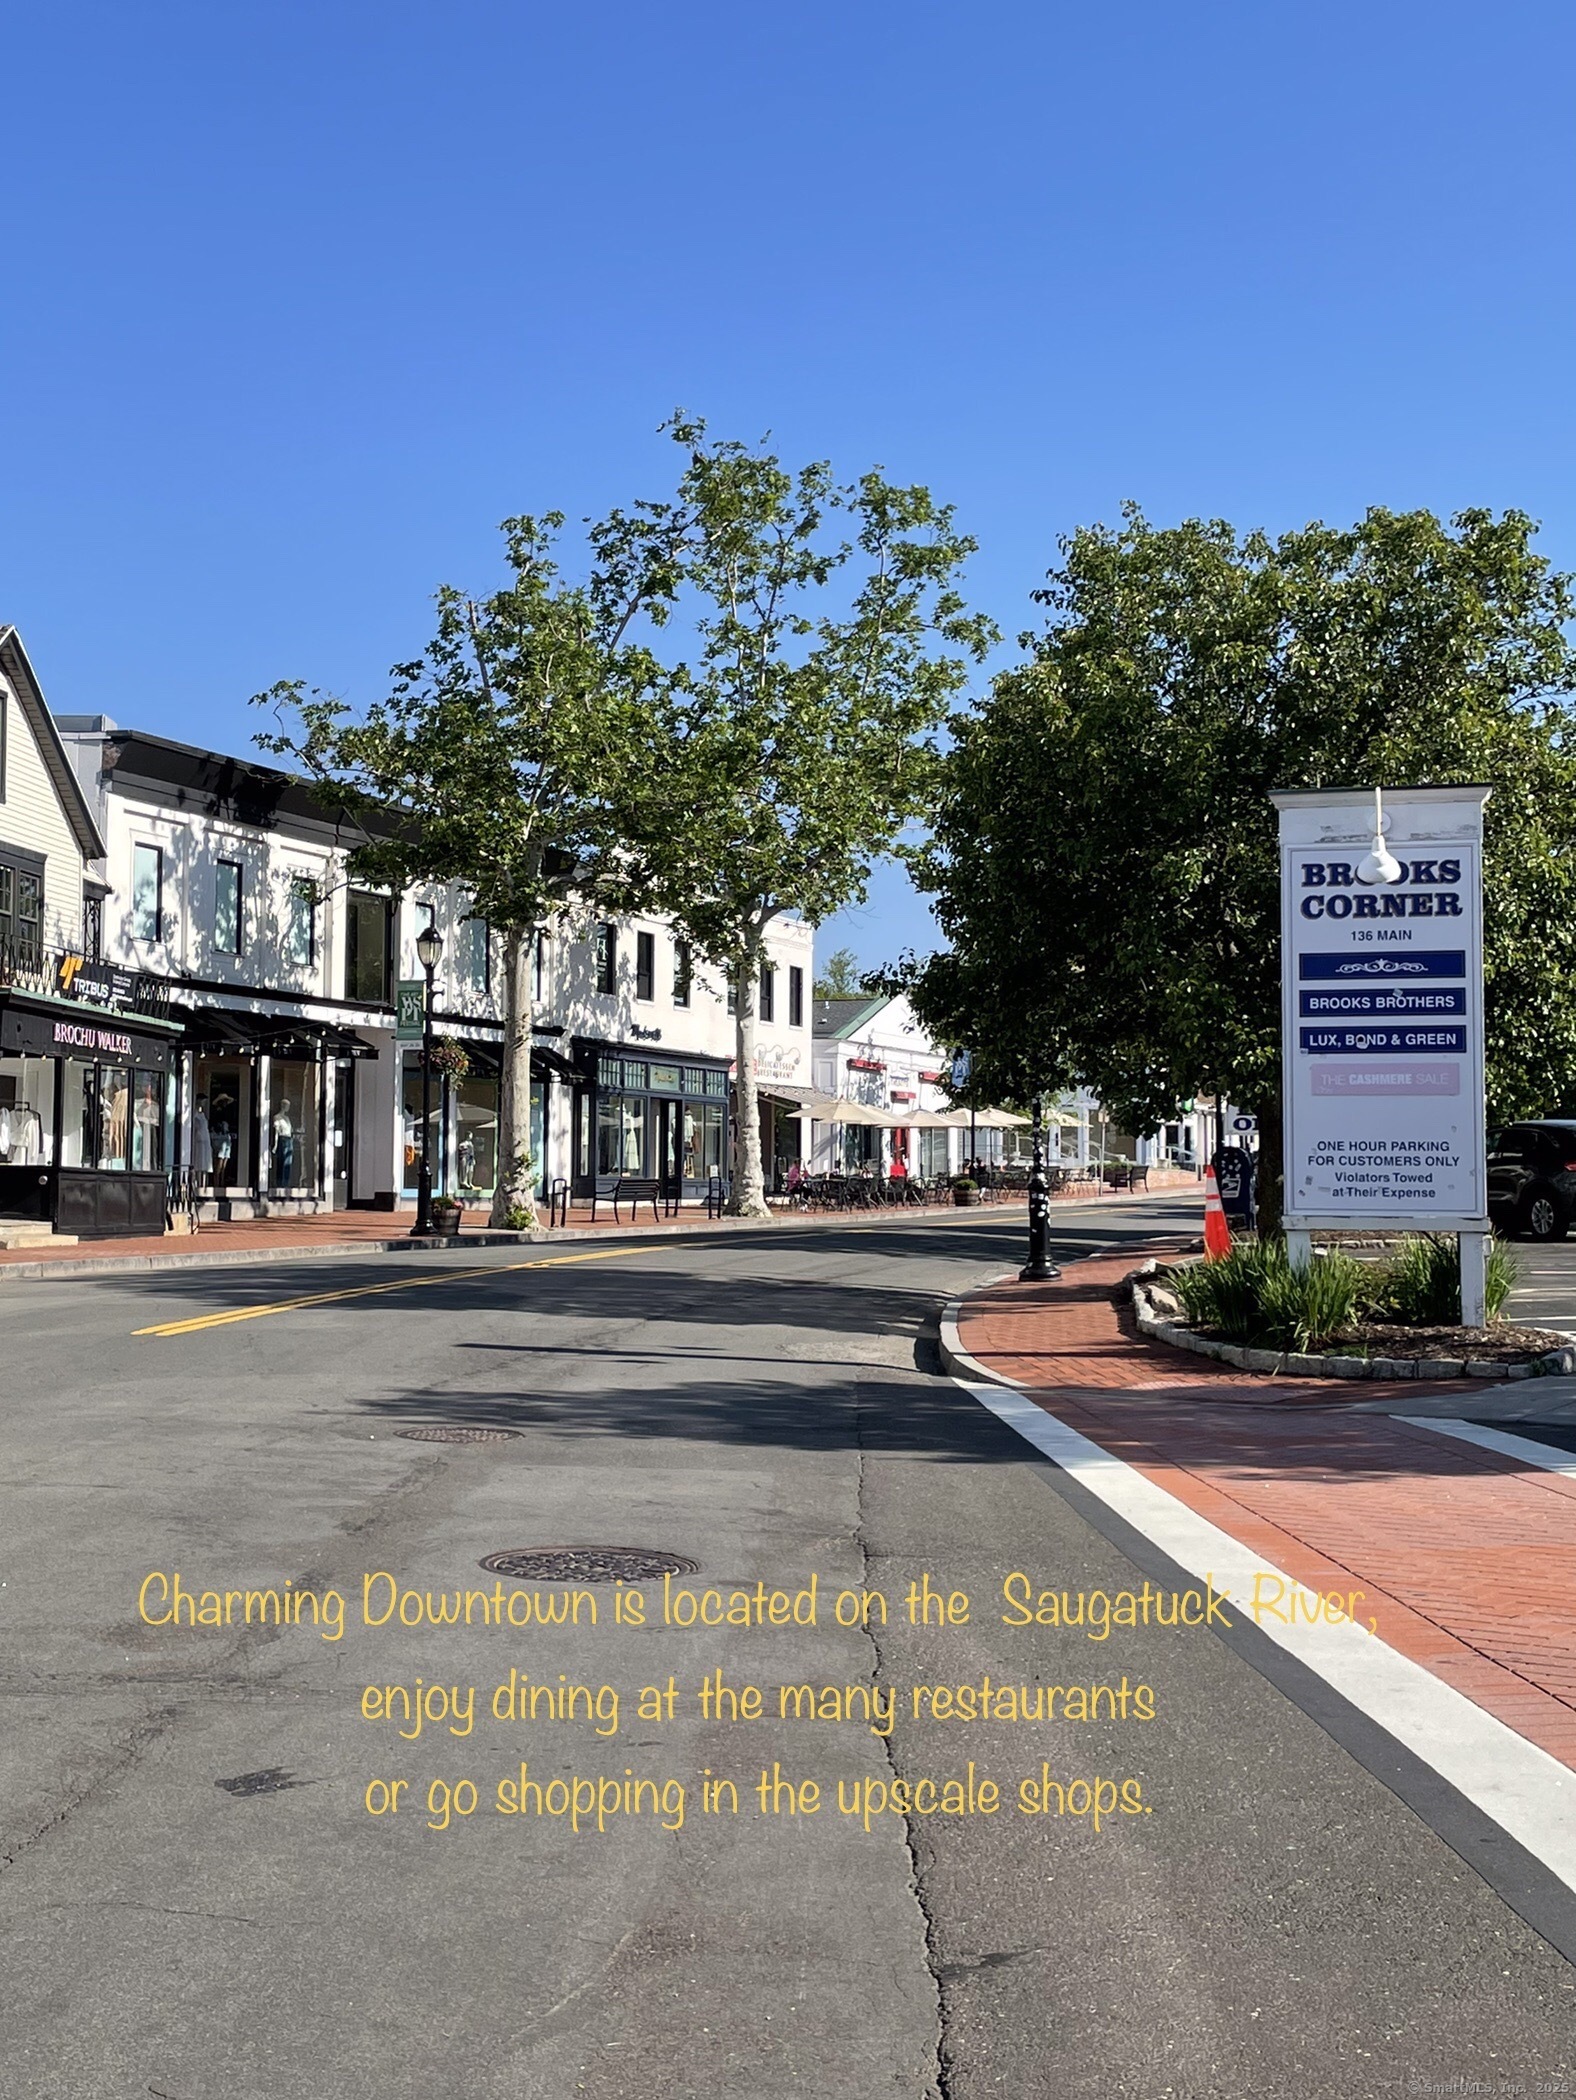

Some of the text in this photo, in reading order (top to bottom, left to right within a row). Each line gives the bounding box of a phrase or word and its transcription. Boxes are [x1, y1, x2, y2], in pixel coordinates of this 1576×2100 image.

[1301, 859, 1461, 887] BRKS
[1300, 892, 1463, 920] CORNER
[1351, 930, 1412, 941] 136 MAIN
[73, 977, 109, 999] TRIBUS
[1309, 996, 1455, 1009] BROOKS BROTHERS
[53, 1022, 132, 1055] BROCHU WALKER
[1309, 1033, 1456, 1048] LUX, BOND & GREEN
[1321, 1072, 1448, 1086] THE CASHMERE SALE
[1317, 1141, 1450, 1152] ONE HOUR PARKING
[1308, 1156, 1460, 1167] FOR CUSTOMERS ONLY
[1335, 1172, 1433, 1183] Violators Towed
[1332, 1187, 1436, 1199] at Their Expense
